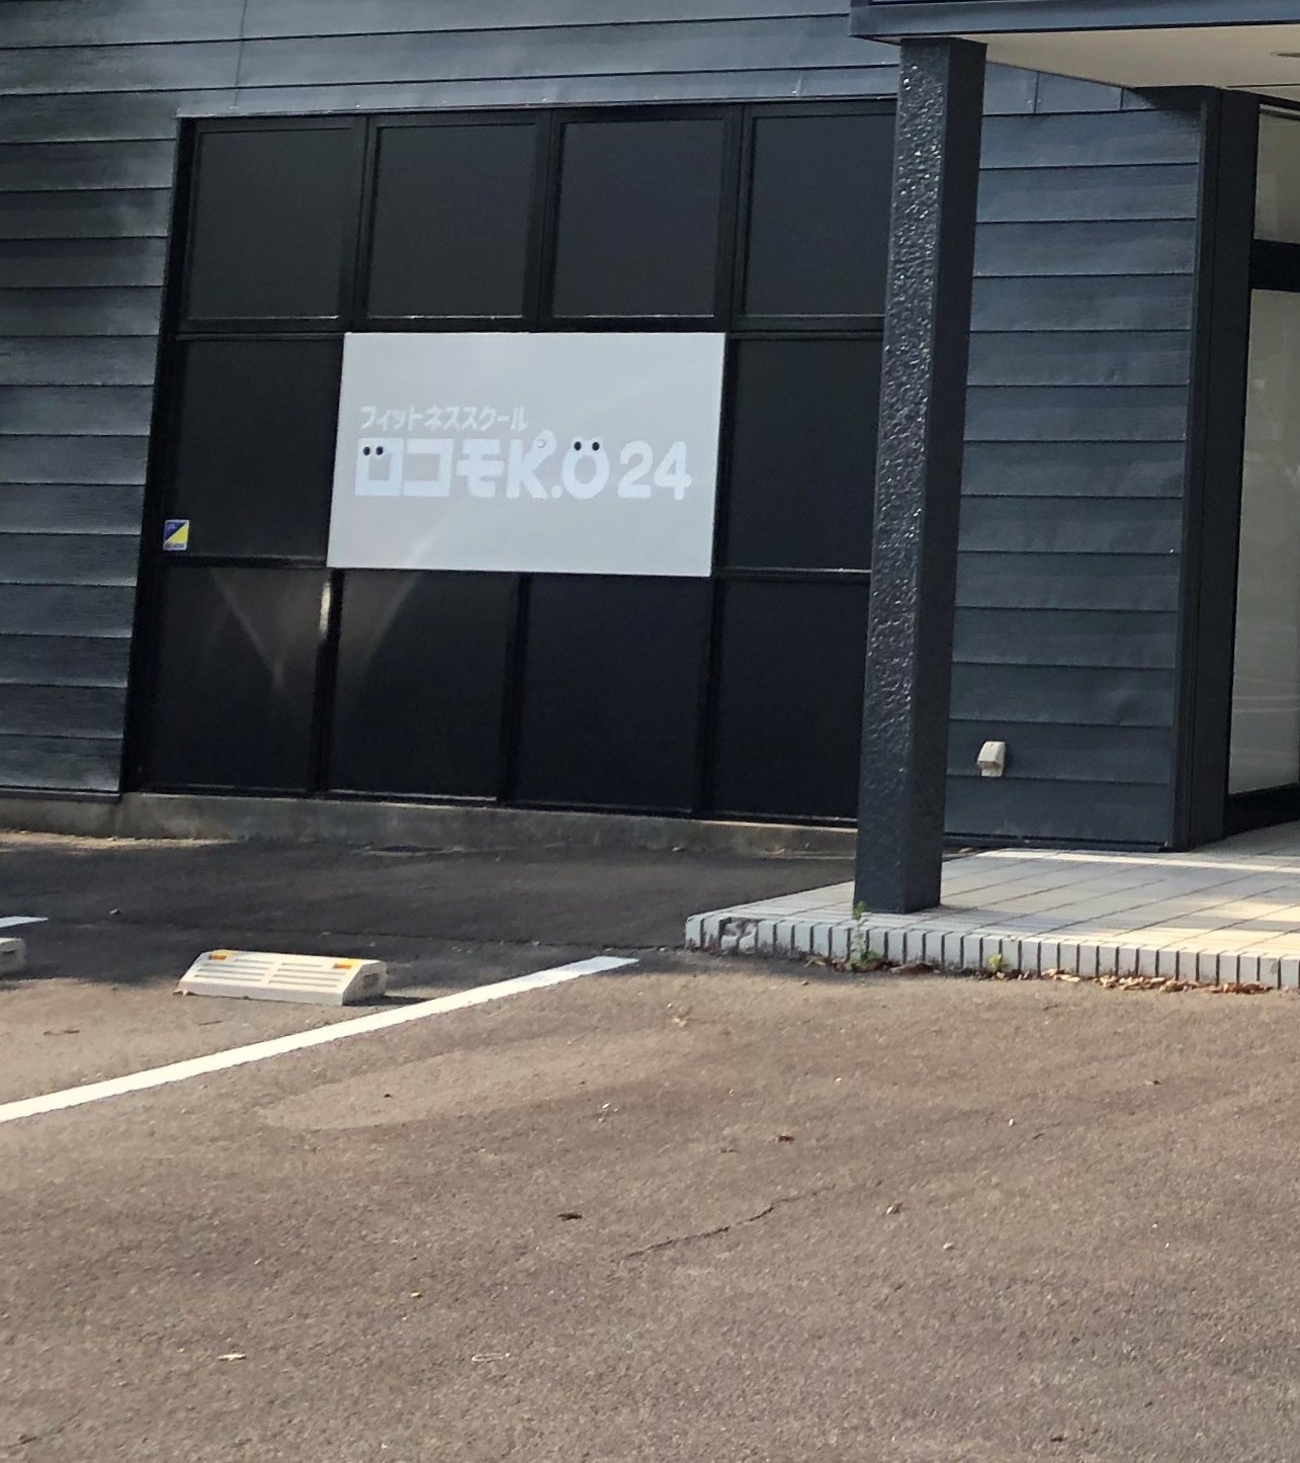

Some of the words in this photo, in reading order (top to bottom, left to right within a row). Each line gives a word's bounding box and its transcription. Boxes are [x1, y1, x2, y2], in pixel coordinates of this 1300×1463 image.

[359, 404, 527, 433] フィットネススクール
